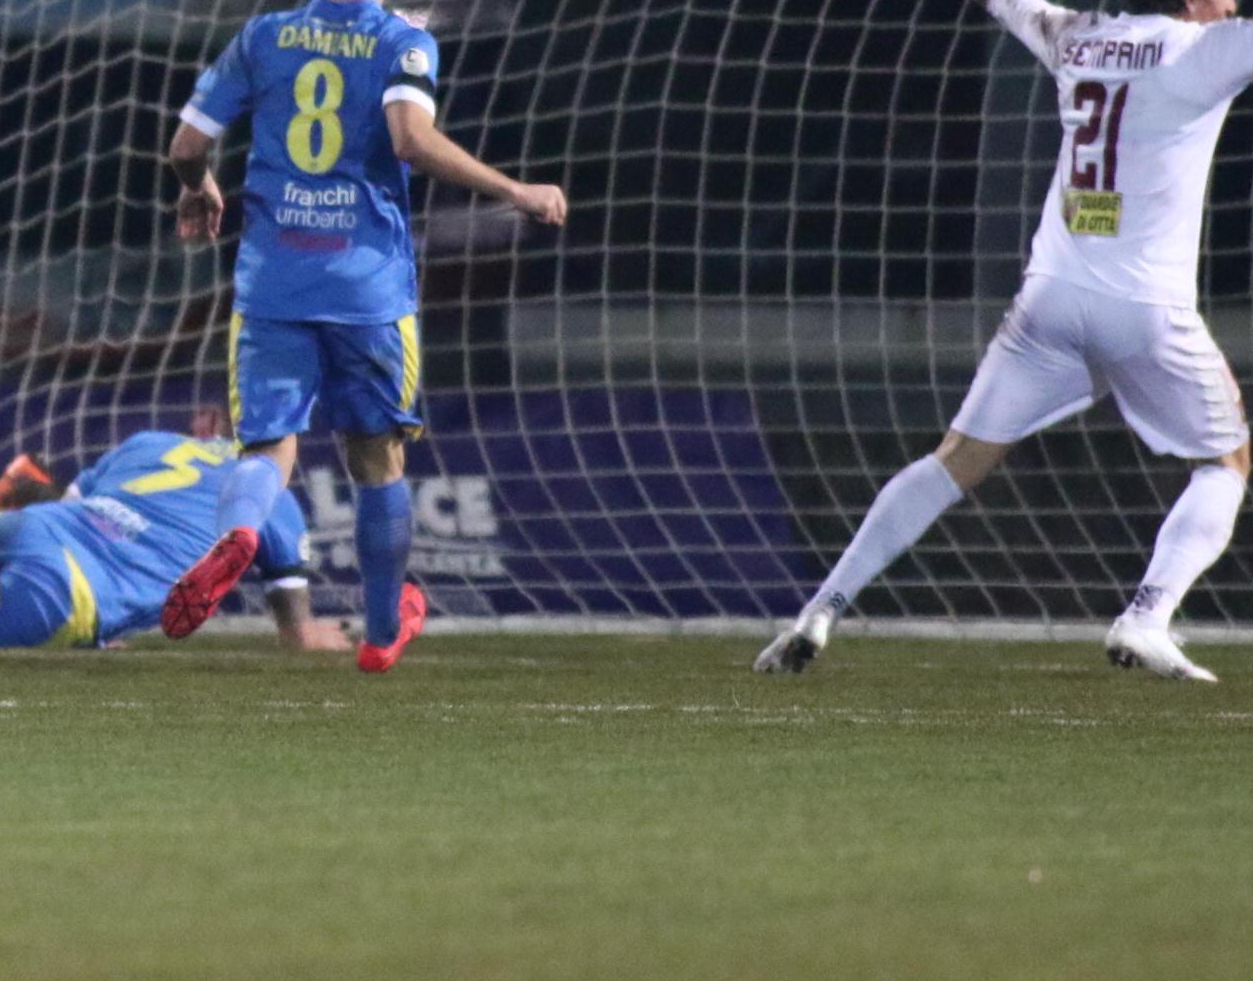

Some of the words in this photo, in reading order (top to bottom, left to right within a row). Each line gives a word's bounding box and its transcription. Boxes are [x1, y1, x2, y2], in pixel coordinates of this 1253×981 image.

[286, 58, 345, 175] 8
[1070, 80, 1129, 192] 21
[275, 206, 357, 230] umberto
[283, 181, 357, 207] franchi
